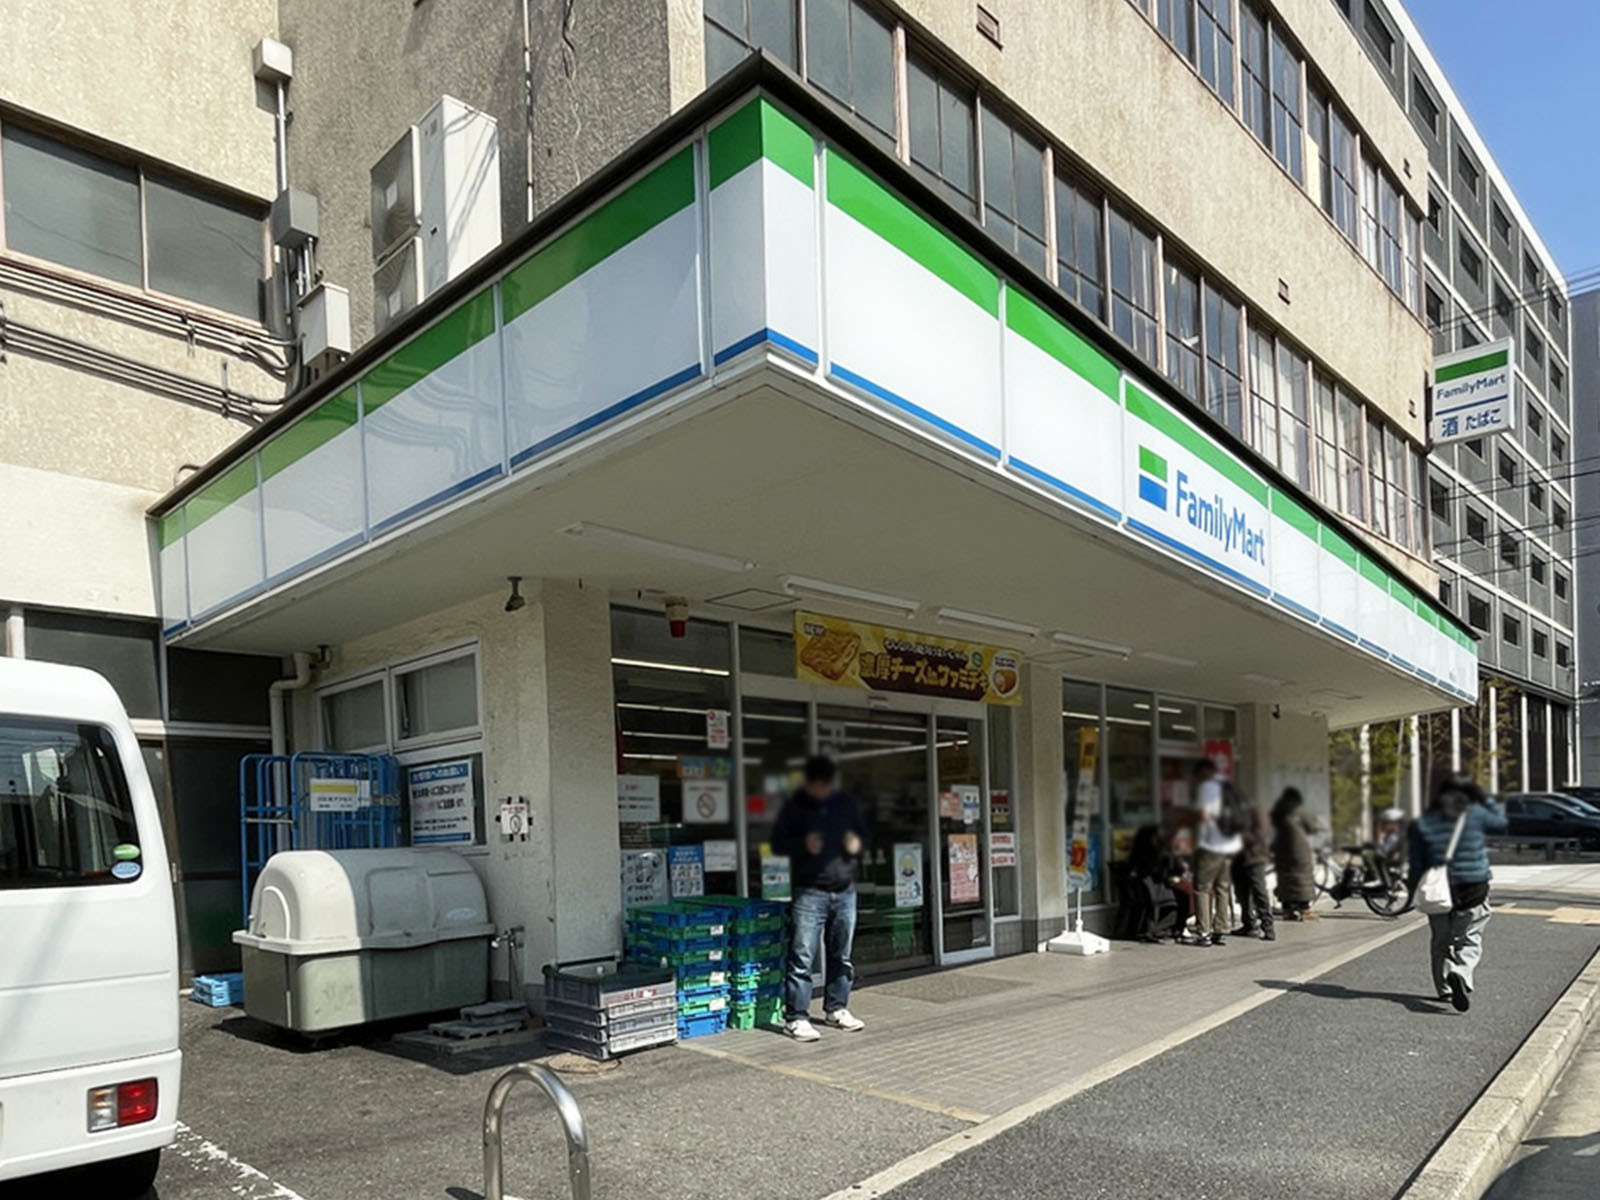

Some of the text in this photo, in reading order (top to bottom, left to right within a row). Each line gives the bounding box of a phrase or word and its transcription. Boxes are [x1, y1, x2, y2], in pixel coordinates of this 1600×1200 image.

[1437, 374, 1505, 399] FamilyMart
[1442, 408, 1501, 437] 酒 たばこ
[1176, 470, 1265, 566] FamilyMart
